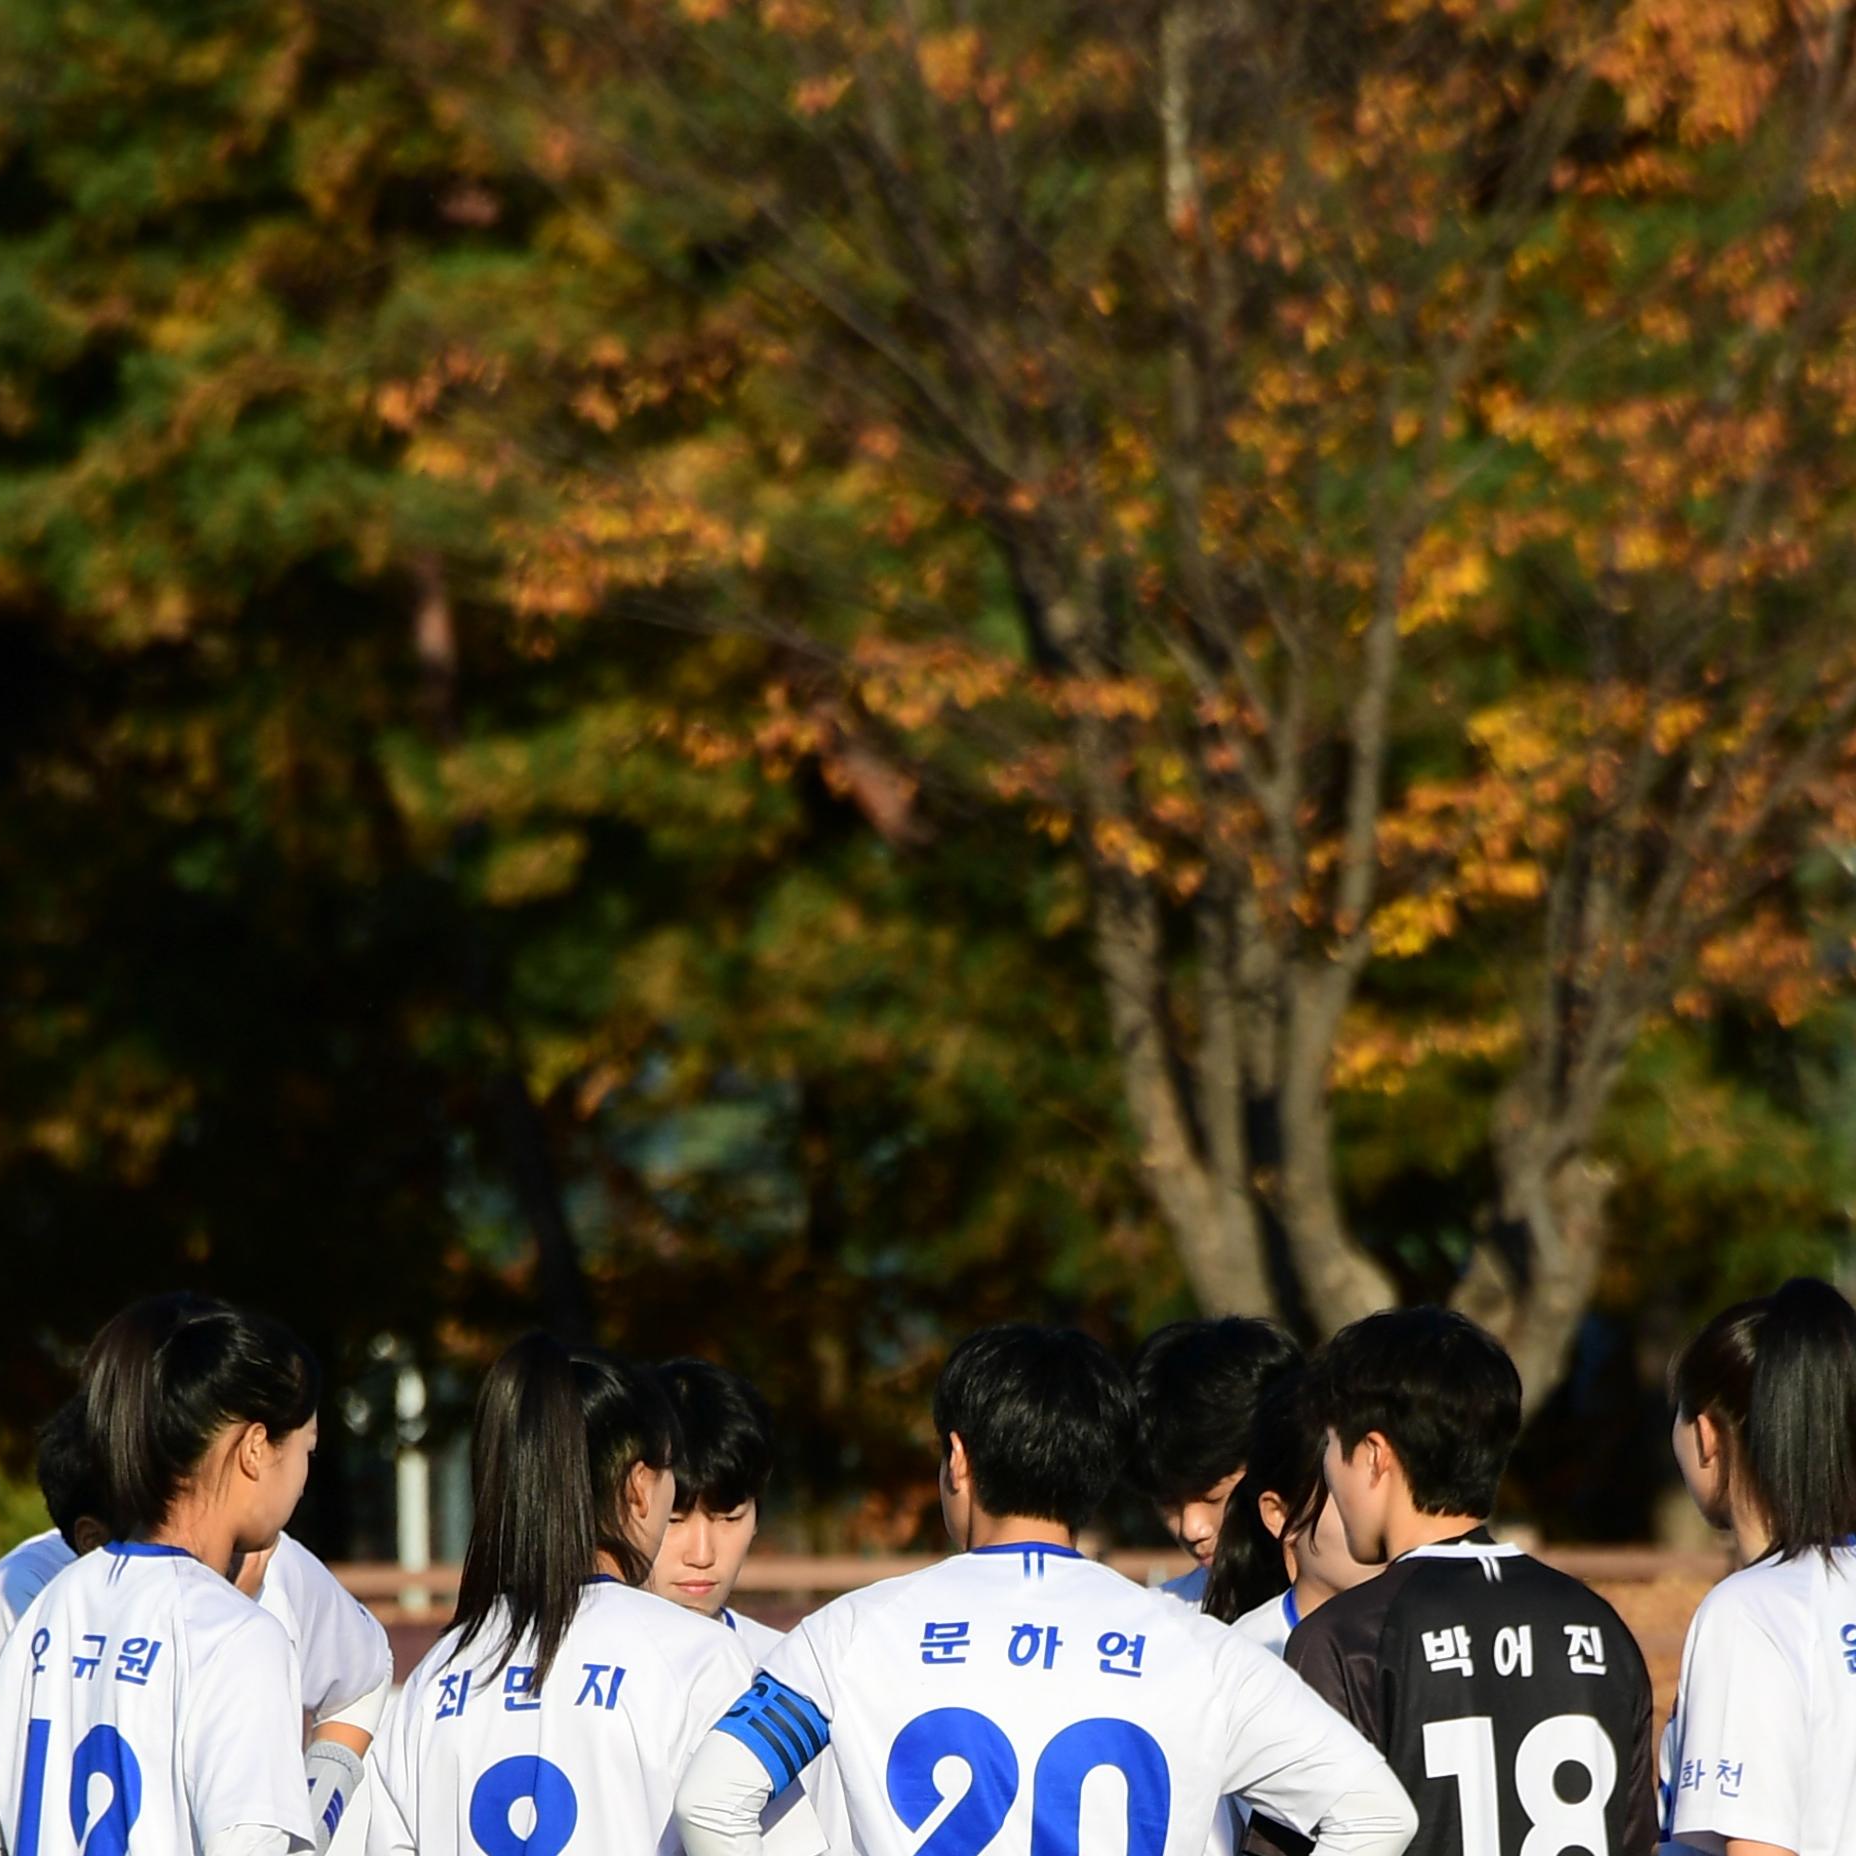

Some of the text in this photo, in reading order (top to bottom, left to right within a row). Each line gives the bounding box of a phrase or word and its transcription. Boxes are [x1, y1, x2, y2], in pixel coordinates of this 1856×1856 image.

[919, 1621, 1147, 1679] 문하연
[1420, 1624, 1608, 1677] 박어진
[1679, 1758, 1744, 1798] 화천
